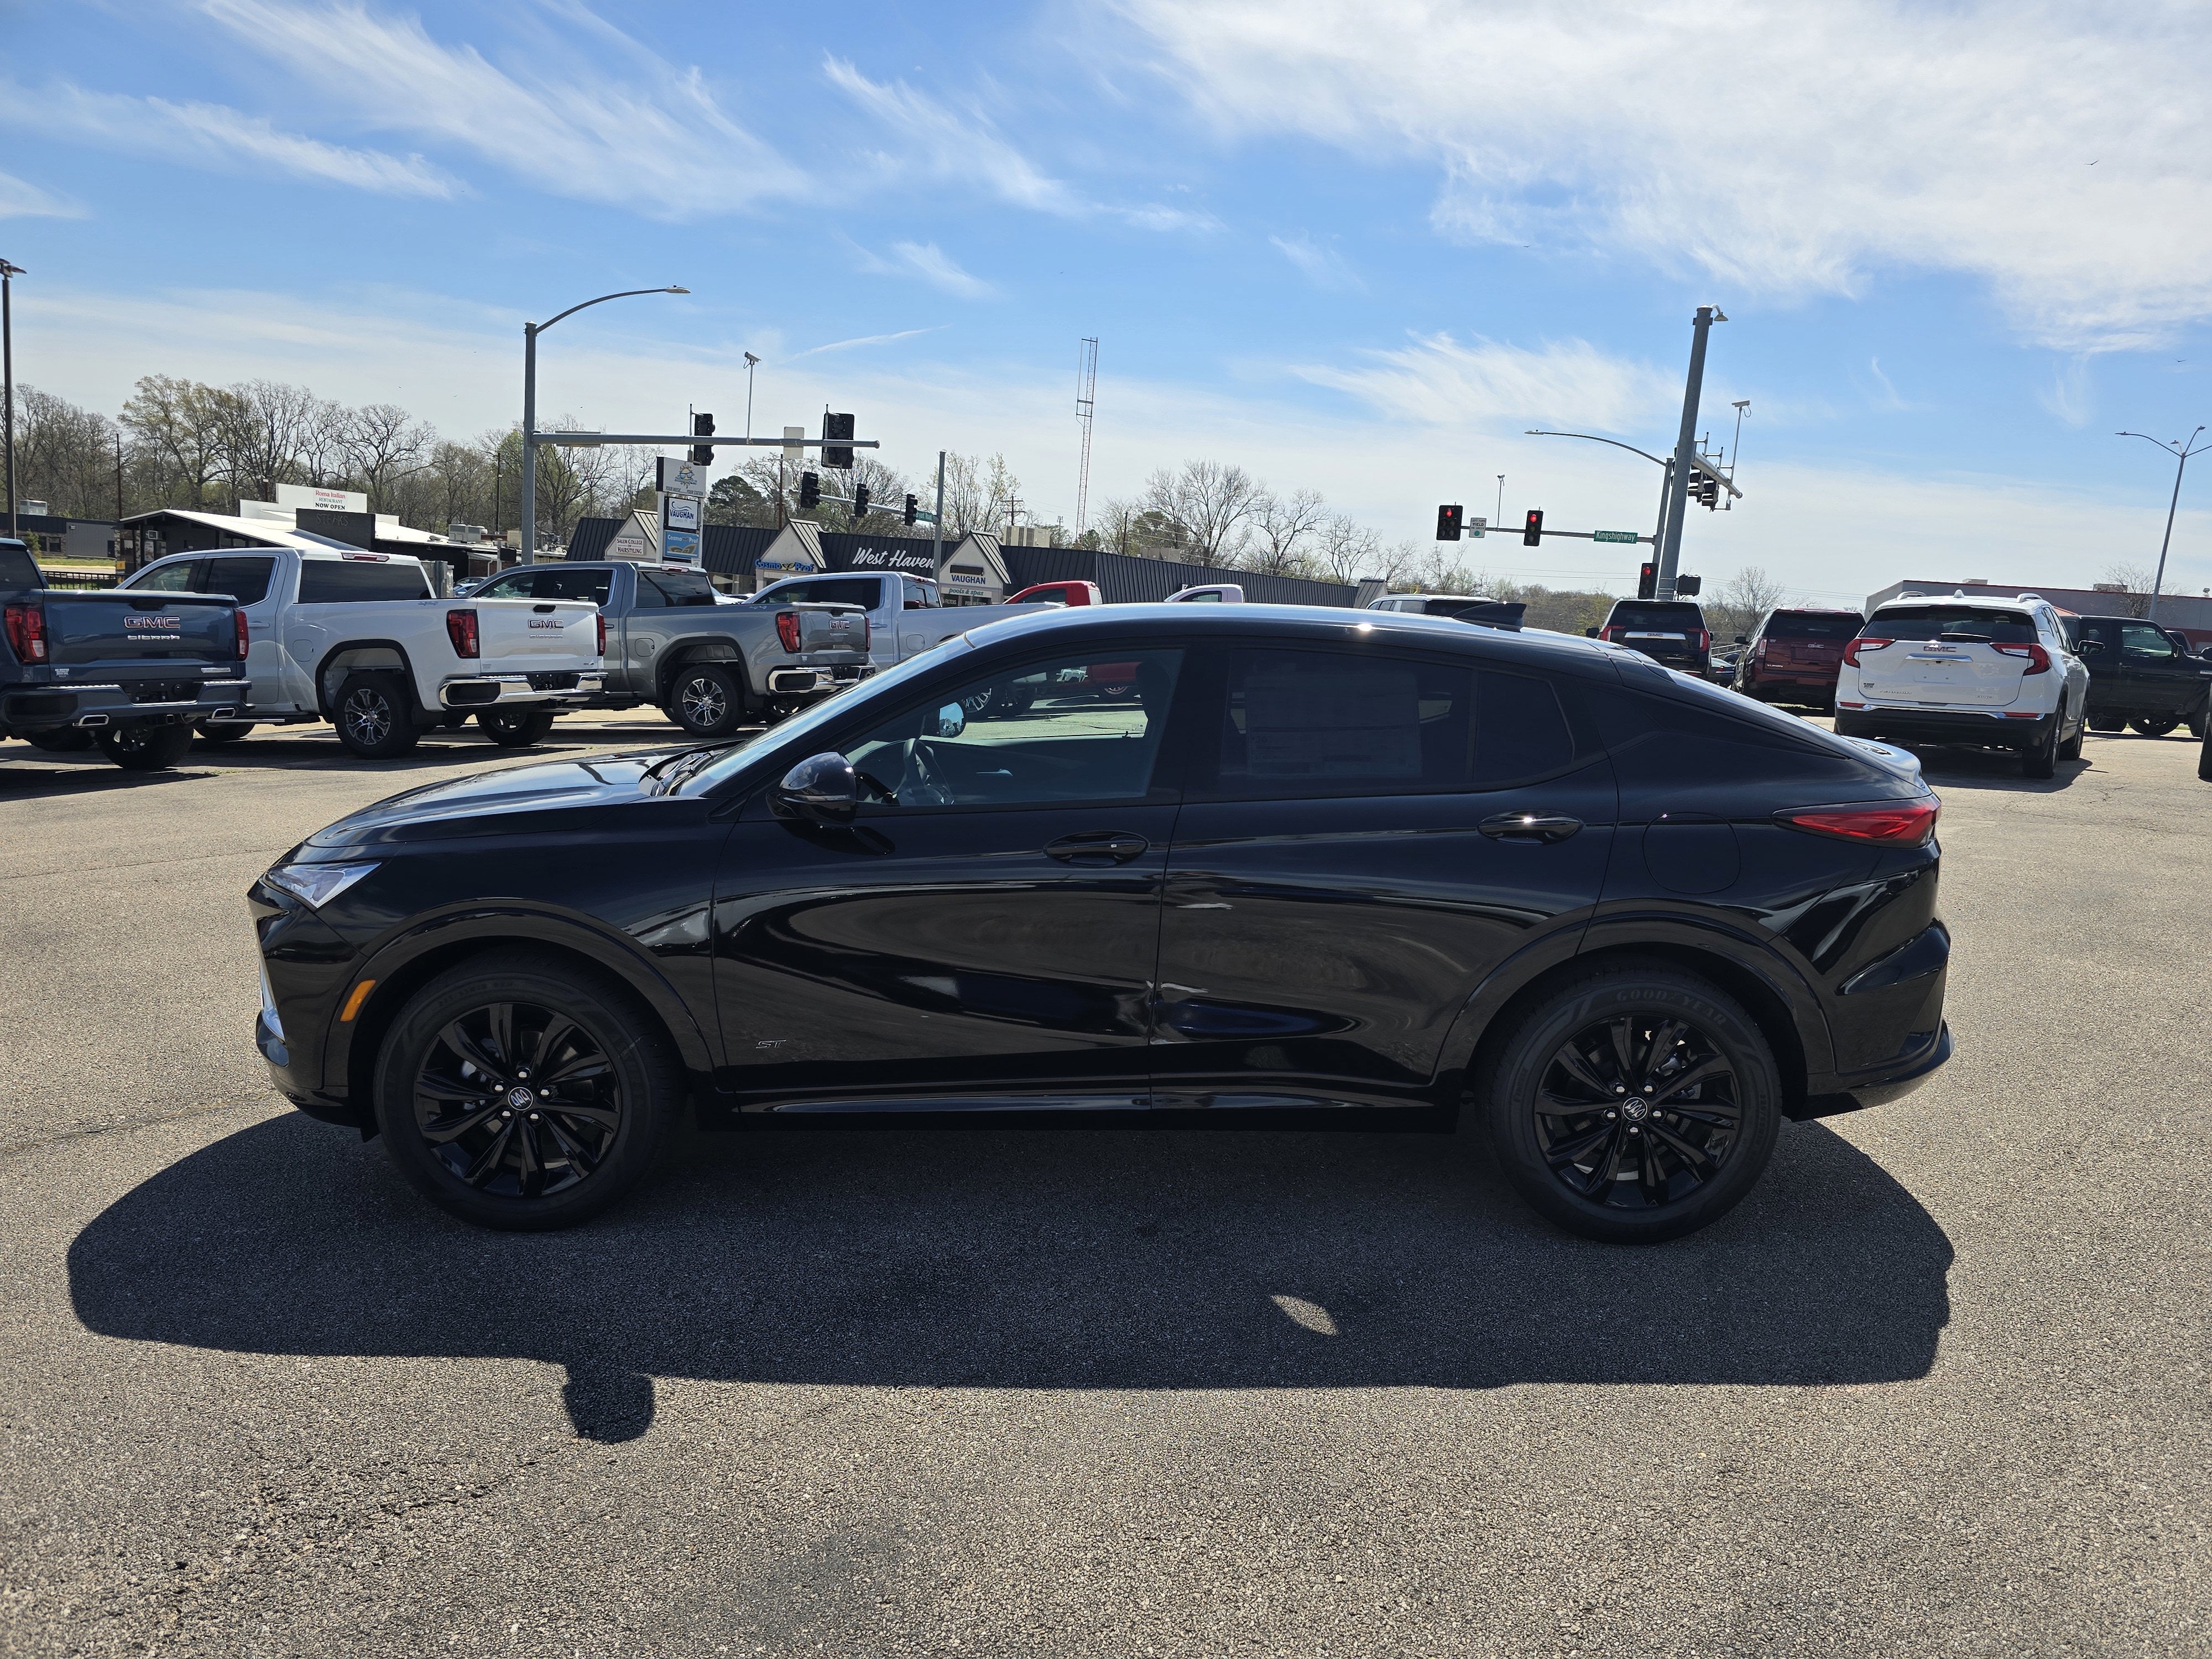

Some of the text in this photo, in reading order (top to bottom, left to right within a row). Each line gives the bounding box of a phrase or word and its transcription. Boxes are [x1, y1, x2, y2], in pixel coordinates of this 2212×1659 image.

[670, 509, 694, 519] VAUGHAN
[316, 513, 349, 526] STEAKS
[1596, 531, 1636, 542] Kingshighway
[852, 547, 934, 568] West Haven
[755, 557, 815, 572] Cosmo Prof
[951, 575, 986, 585] VAUGHAN
[123, 615, 181, 629] GMC
[528, 619, 564, 629] GMC
[829, 620, 851, 630] GMC
[755, 1039, 787, 1049] ST
